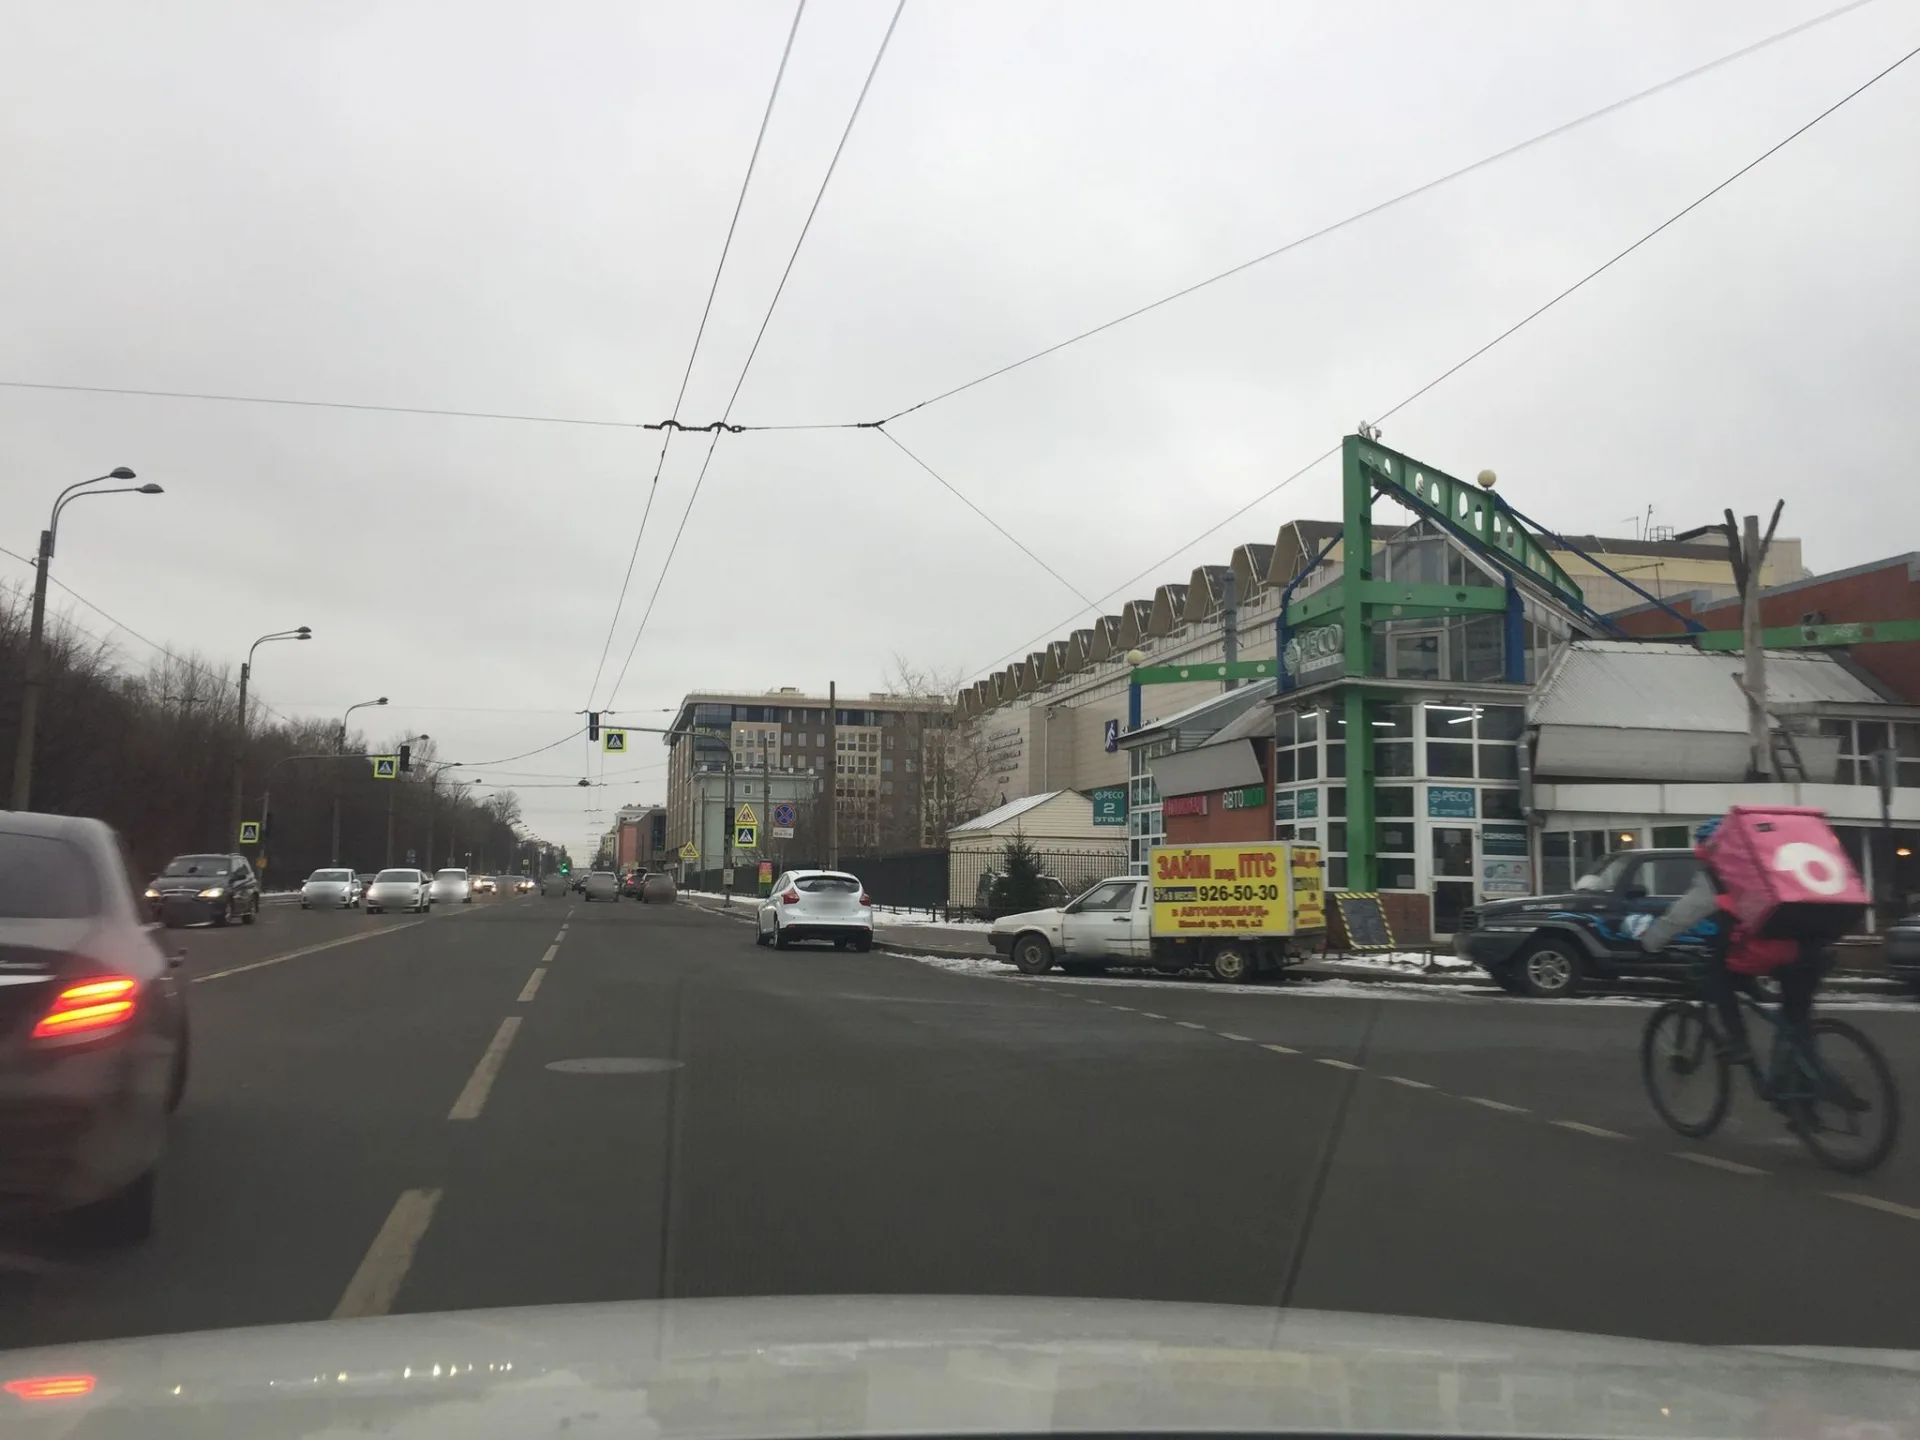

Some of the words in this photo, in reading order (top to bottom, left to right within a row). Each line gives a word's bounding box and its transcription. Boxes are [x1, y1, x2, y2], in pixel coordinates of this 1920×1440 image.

[1103, 802, 1116, 814] 2
[1157, 850, 1211, 880] ЗАЙМ
[1238, 852, 1277, 878] ПТС
[1199, 884, 1278, 902] 926-50-30
